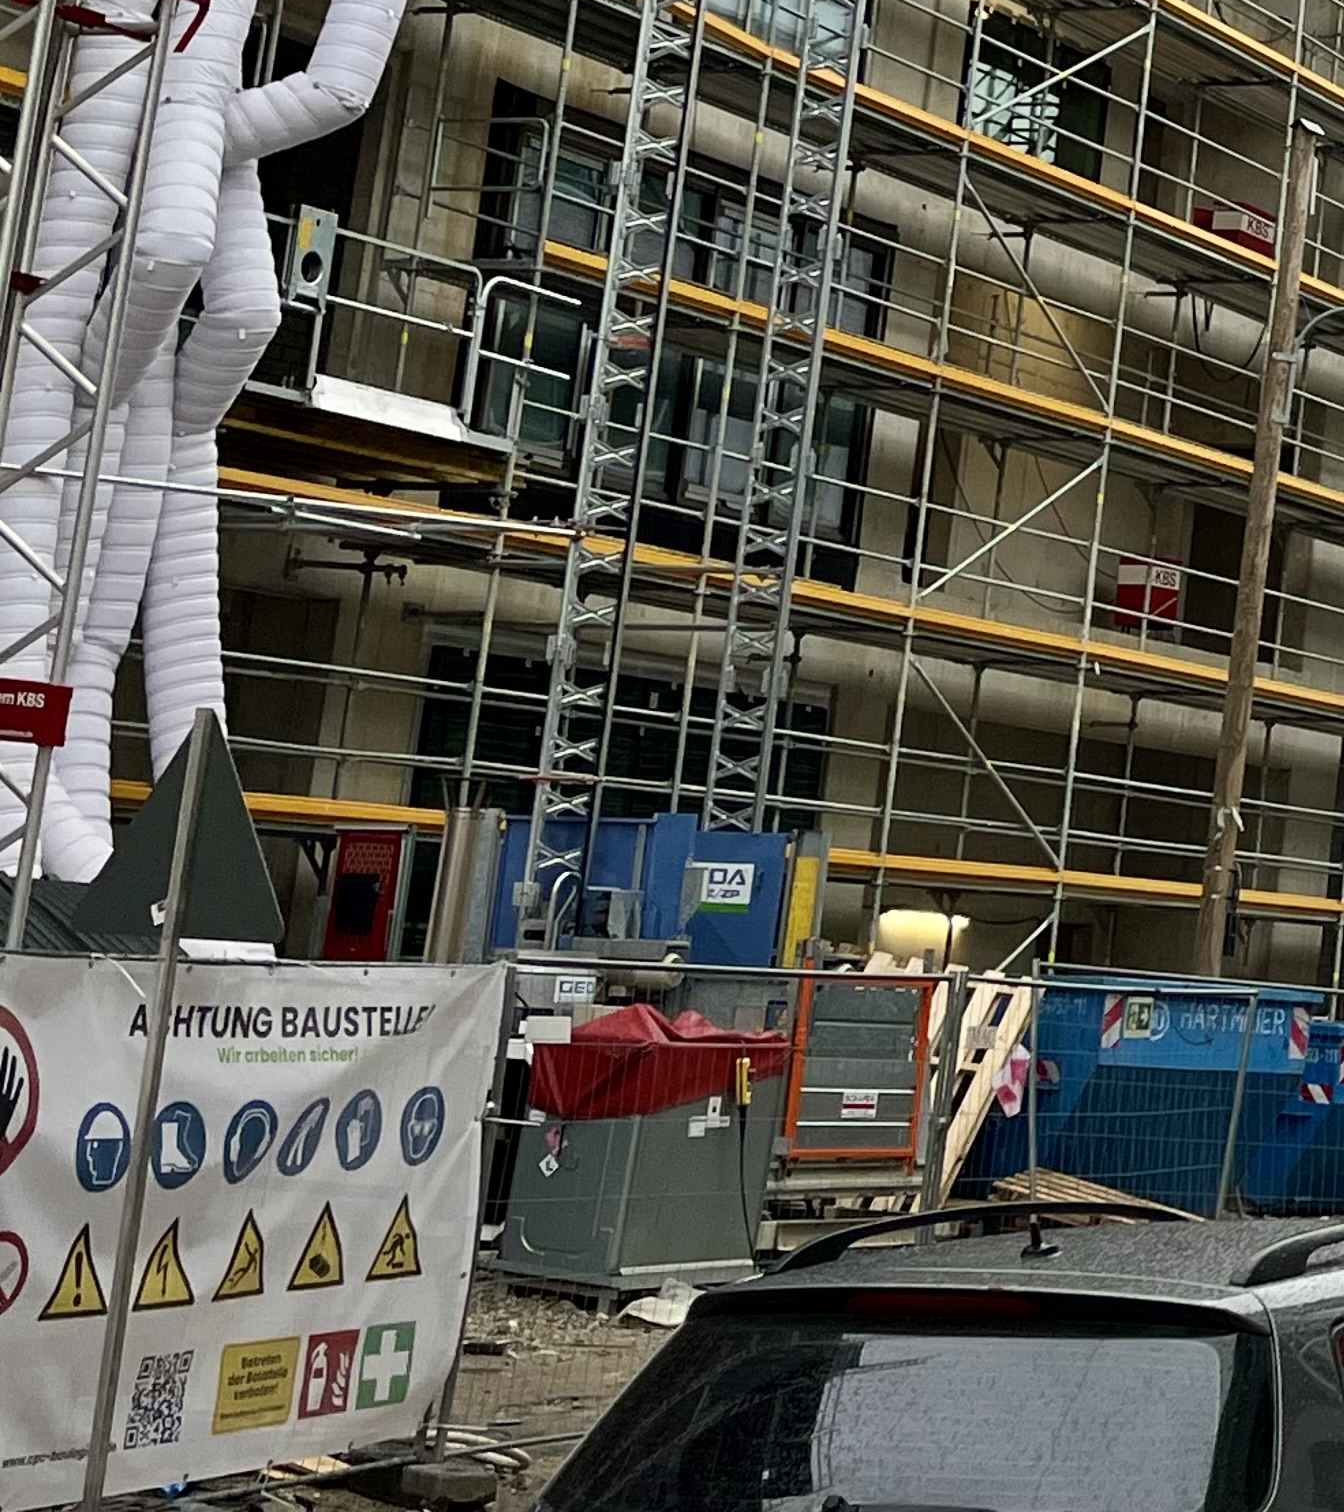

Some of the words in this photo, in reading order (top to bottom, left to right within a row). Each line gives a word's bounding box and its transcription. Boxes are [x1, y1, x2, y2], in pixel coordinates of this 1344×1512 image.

[1155, 569, 1177, 587] KBS
[16, 691, 46, 708] KBS
[128, 1003, 273, 1038] AHTUNG
[1180, 1003, 1286, 1035] HARTMIER
[216, 1047, 242, 1064] Wir
[245, 1047, 307, 1064] arbeiten
[309, 1045, 359, 1064] sicher!
